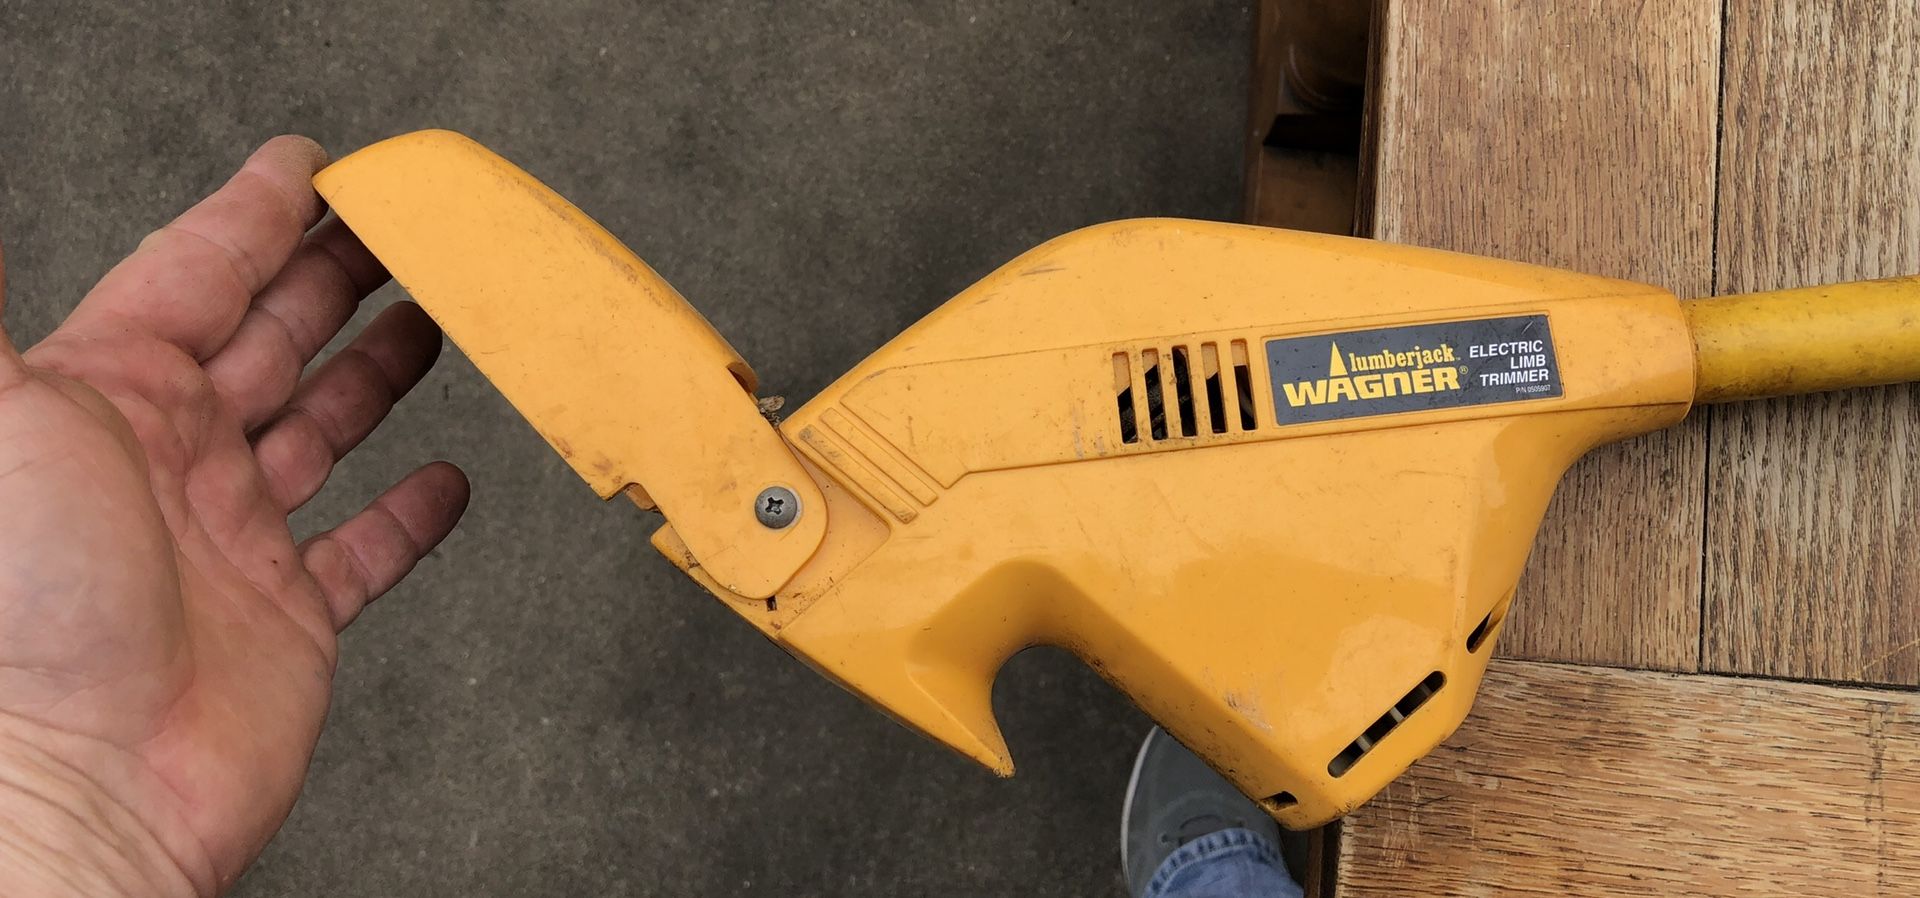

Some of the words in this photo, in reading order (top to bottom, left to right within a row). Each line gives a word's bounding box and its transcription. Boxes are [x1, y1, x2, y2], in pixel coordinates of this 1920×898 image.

[1350, 344, 1456, 371] lumberjack
[1469, 340, 1543, 358] ELECTRIC
[1510, 355, 1546, 369] LIMB
[1479, 369, 1549, 387] TRIMMER
